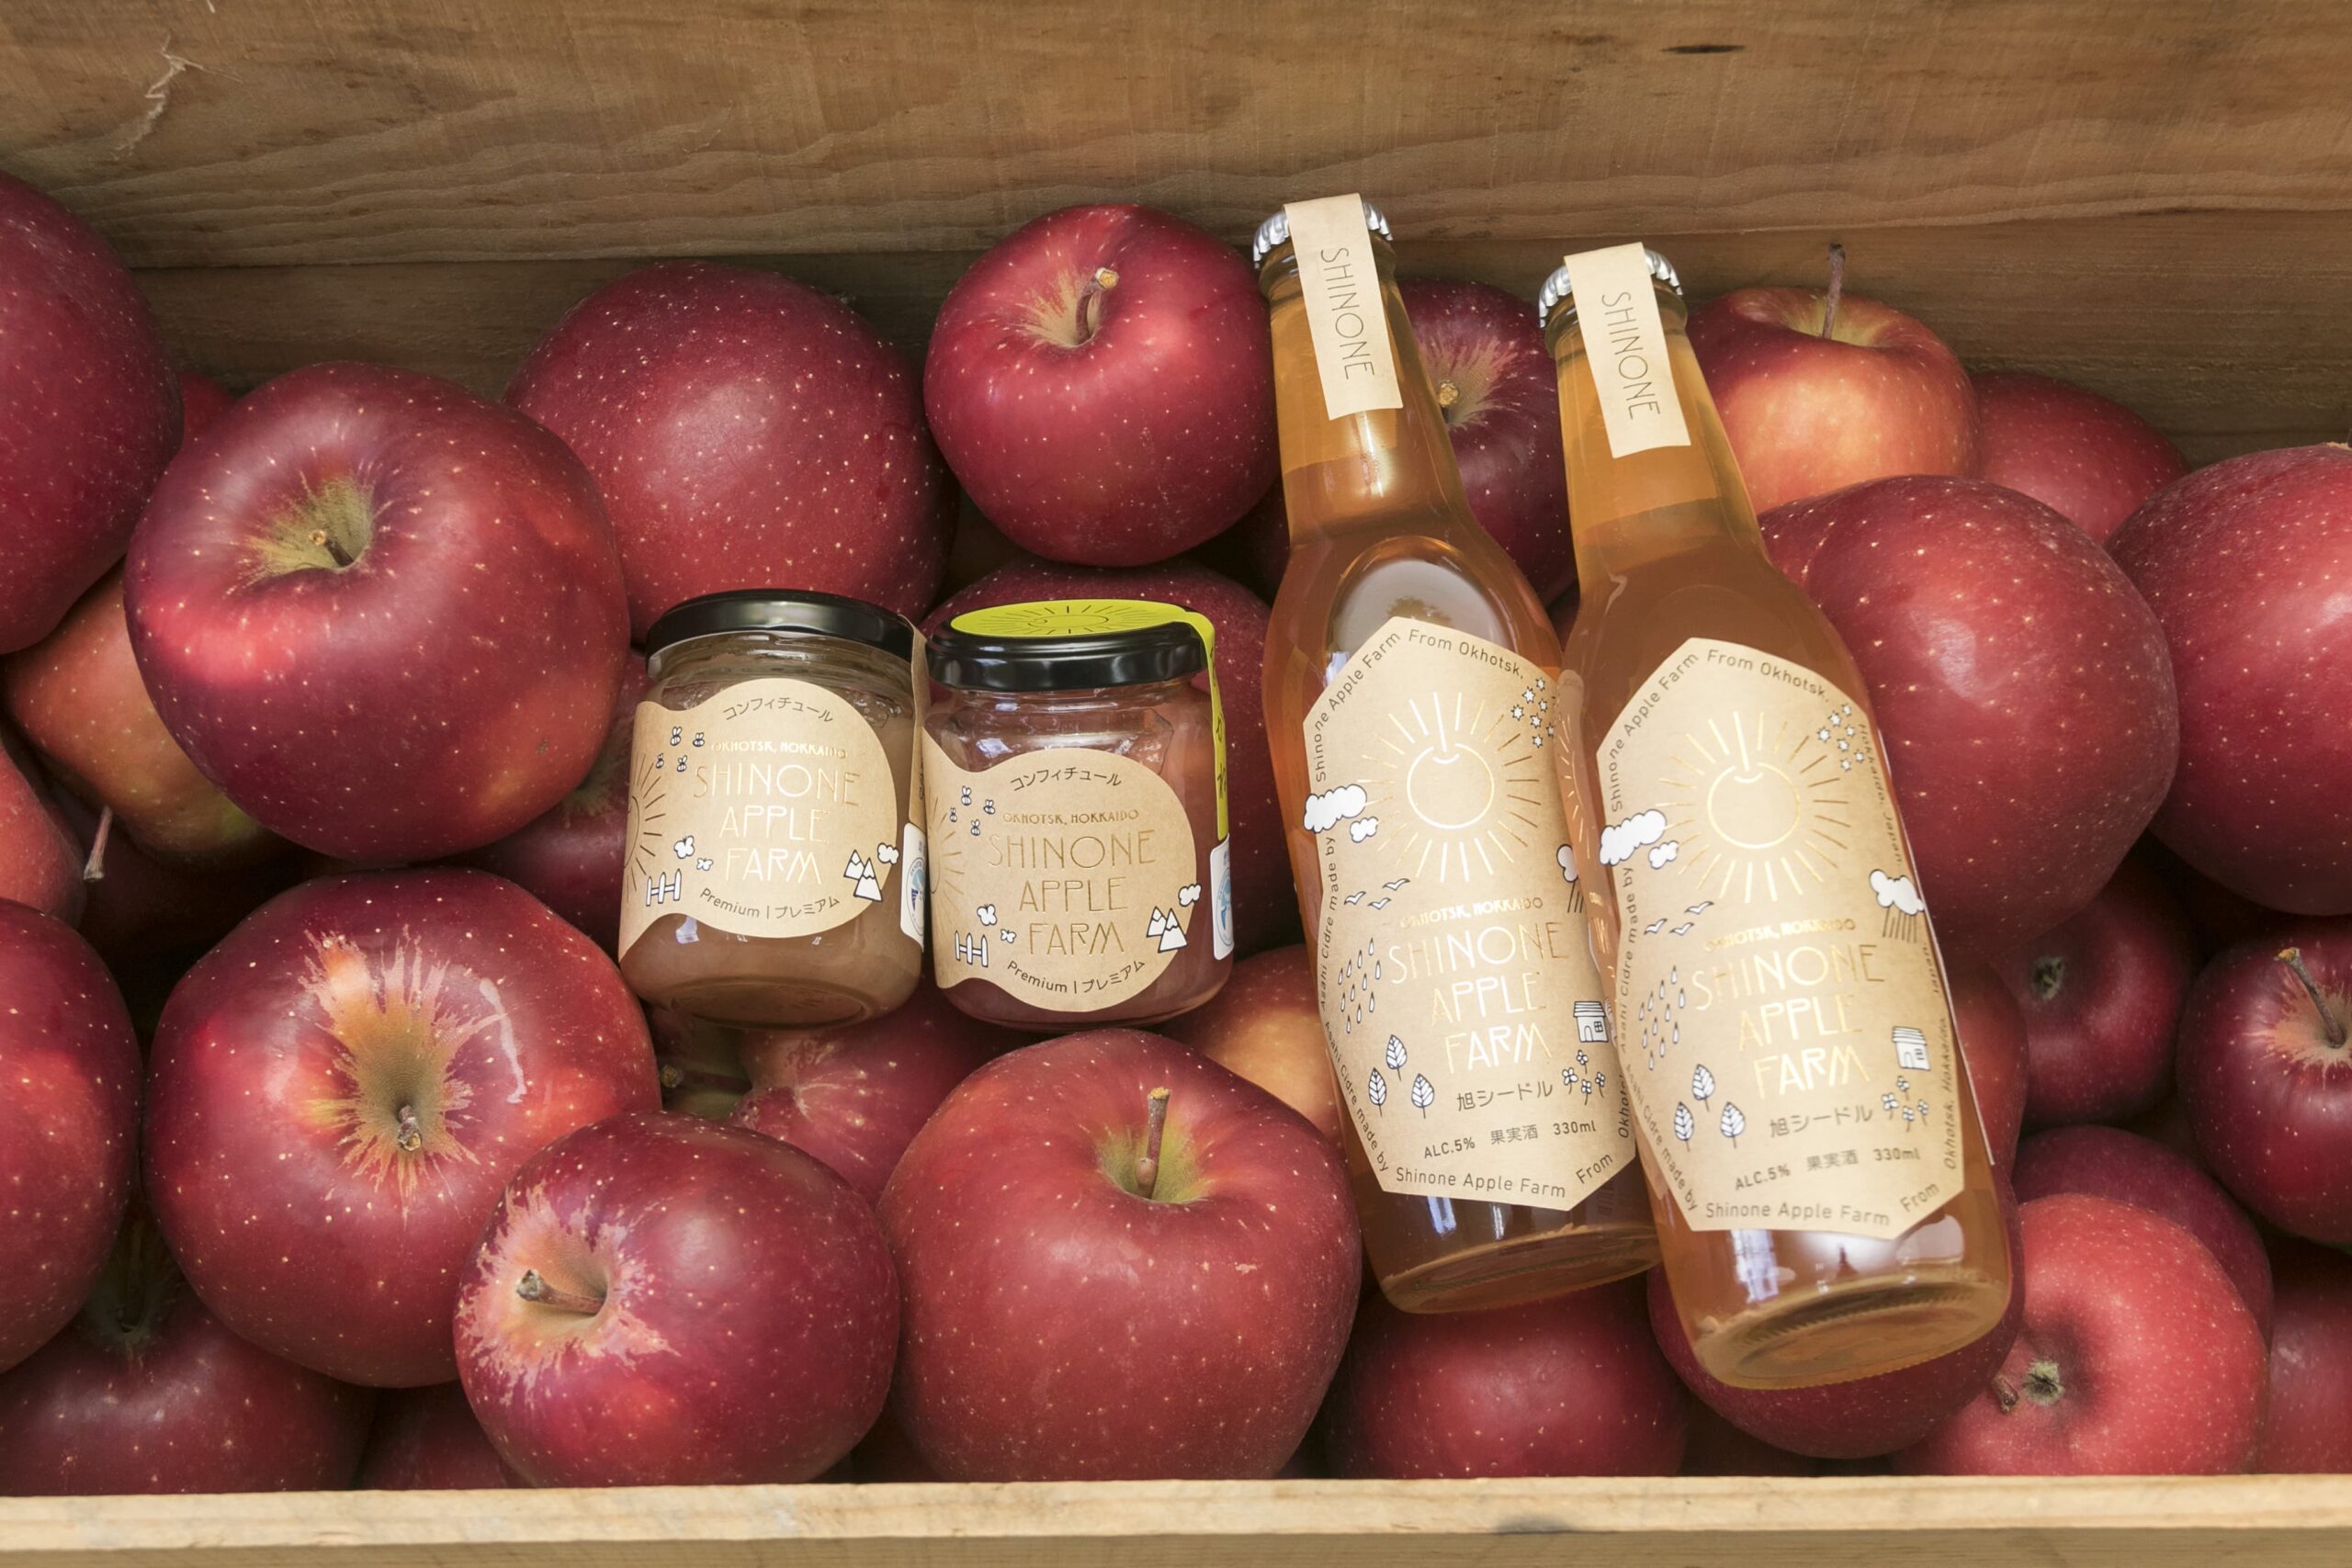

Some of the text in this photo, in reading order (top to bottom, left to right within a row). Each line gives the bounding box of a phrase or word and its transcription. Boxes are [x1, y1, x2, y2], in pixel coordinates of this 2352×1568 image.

[1320, 247, 1374, 379] SHINONE
[1601, 291, 1661, 420] SHINONE
[1408, 629, 1524, 679] From Okhotsk,
[1707, 649, 1829, 703] From Okhotsk,
[723, 697, 833, 722] コンフィチュール
[1313, 631, 1401, 783] Shinone Apple Farm
[1609, 652, 1700, 812] Shinone Apple Farm
[693, 762, 861, 807] SHINONE
[1011, 766, 1122, 791] コンフィチュール
[718, 805, 830, 844] APPLE
[1002, 809, 1139, 826] OKHOTSK, HOKKAIDO
[726, 847, 821, 885] FARM
[989, 829, 1156, 869] SHINONE
[1325, 837, 1336, 856] by
[1019, 876, 1128, 913] APPLE
[1329, 863, 1339, 911] made
[1623, 867, 1634, 887] by
[700, 887, 760, 918] Premium
[775, 897, 841, 919] プレミアム
[1626, 893, 1639, 944] made
[1029, 921, 1125, 956] FARM
[1321, 916, 1333, 959] Cidre
[1388, 922, 1568, 984] SHINONE
[1007, 960, 1068, 993] Premium
[1082, 960, 1146, 993] プレミアム
[1621, 951, 1634, 997] Cidre
[1691, 944, 1885, 1010] SHINONE
[1431, 972, 1546, 1027] APPLE
[1739, 994, 1862, 1051] APPLE
[1445, 1022, 1552, 1075] FARM
[1754, 1044, 1871, 1100] FARM
[1456, 1079, 1554, 1112] 旭シードル
[1340, 1064, 1358, 1103] Cidre
[1356, 1108, 1377, 1149] made
[1376, 1152, 1389, 1172] by
[1424, 1120, 1597, 1159] ALC.5% 果実酒 330ml
[1770, 1104, 1873, 1138] 旭シードル
[1575, 1153, 1613, 1185] From
[1643, 1105, 1663, 1145] Cidre
[1661, 1148, 1686, 1190] made
[1684, 1190, 1698, 1211] by
[1736, 1147, 1921, 1190] ALC.5% 果実酒 330ml
[1396, 1167, 1566, 1198] Shinone Apple Farm
[1900, 1181, 1940, 1213] From
[1706, 1202, 1890, 1226] Shinone Apple Farm
